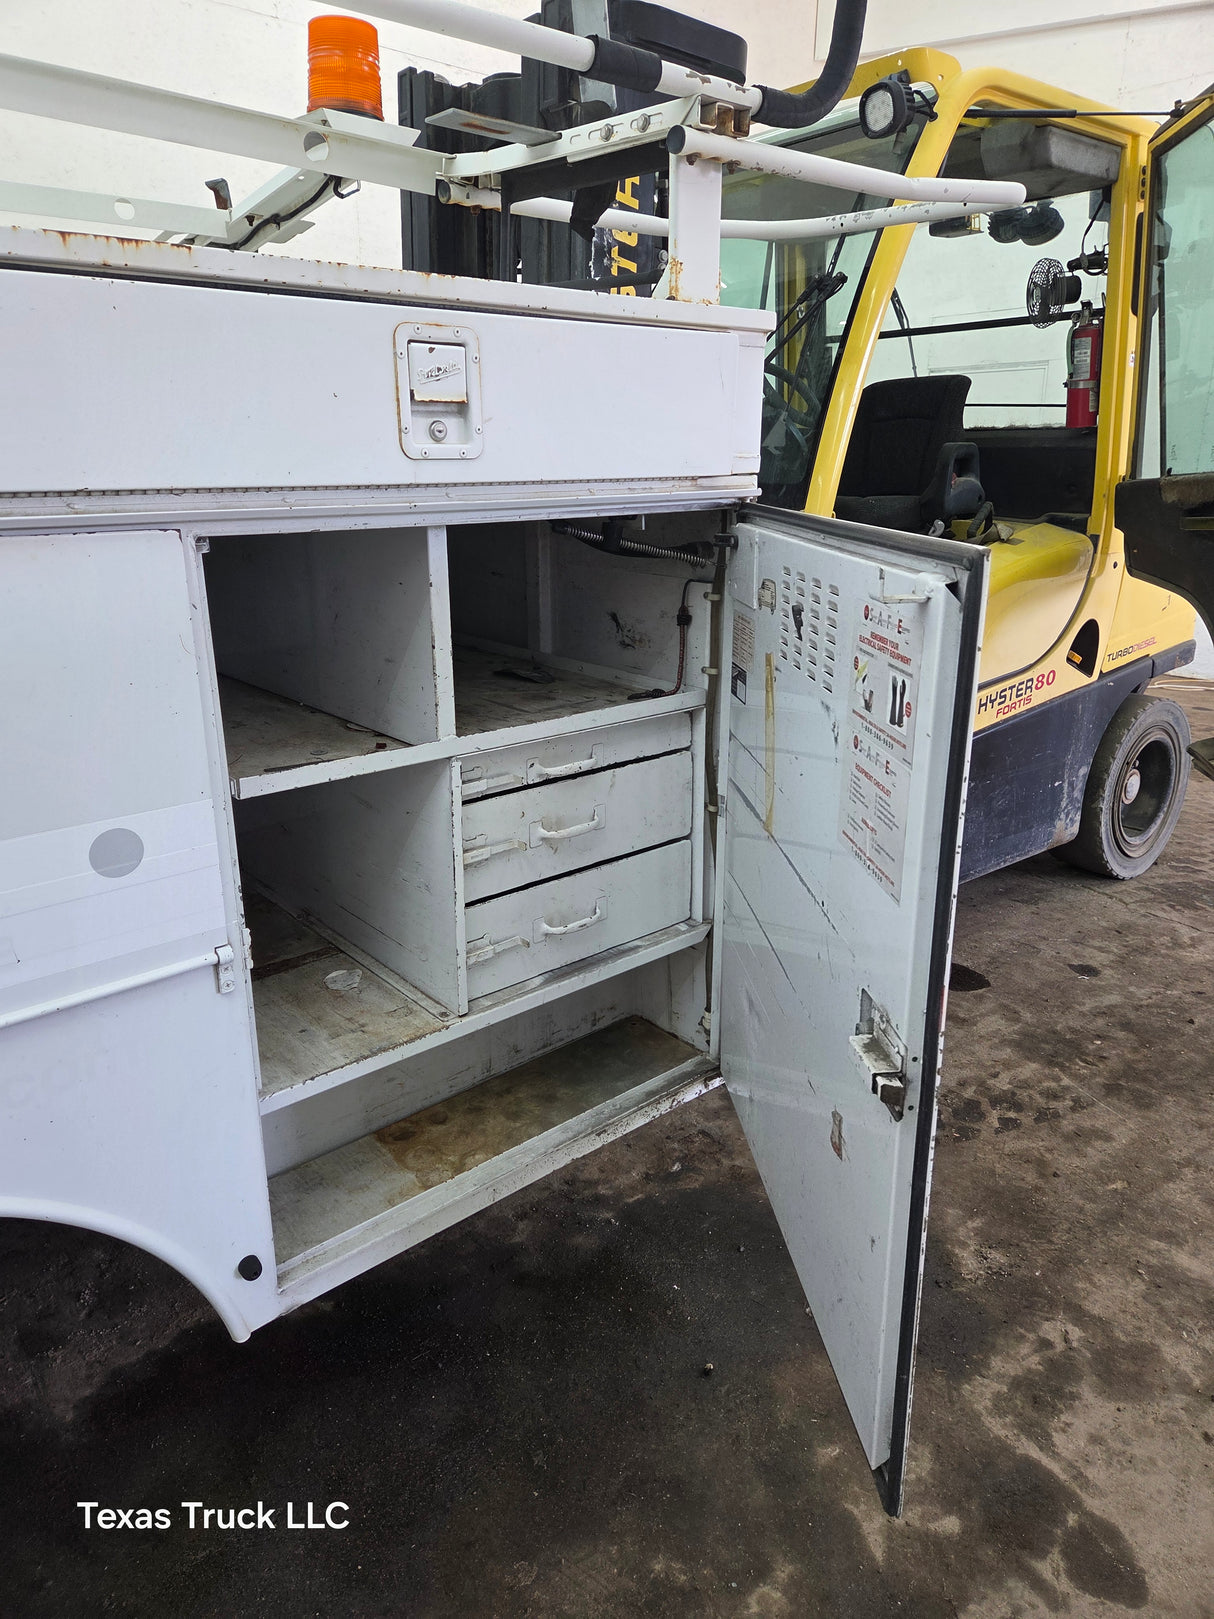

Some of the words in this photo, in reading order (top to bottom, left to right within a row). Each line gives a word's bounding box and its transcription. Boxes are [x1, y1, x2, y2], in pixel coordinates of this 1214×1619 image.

[978, 677, 1034, 715] HYSTER
[1034, 669, 1057, 691] 80
[995, 694, 1033, 719] FORTIS
